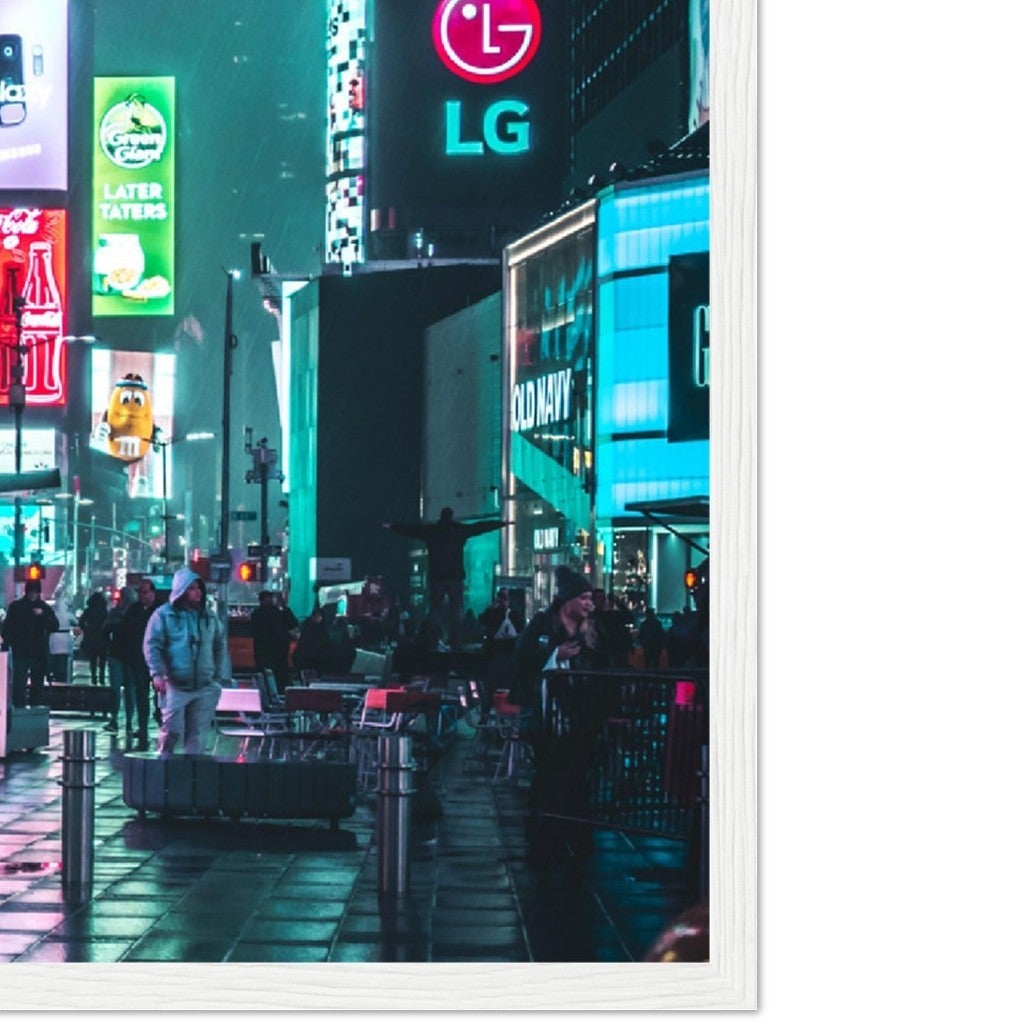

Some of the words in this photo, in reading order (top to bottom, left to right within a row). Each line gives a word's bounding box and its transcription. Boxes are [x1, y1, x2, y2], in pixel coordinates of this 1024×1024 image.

[446, 100, 530, 155] LG
[108, 129, 162, 146] Green
[104, 182, 163, 200] LATER
[99, 203, 167, 220] TATERS
[513, 380, 535, 432] OLD
[536, 368, 572, 426] NAVY
